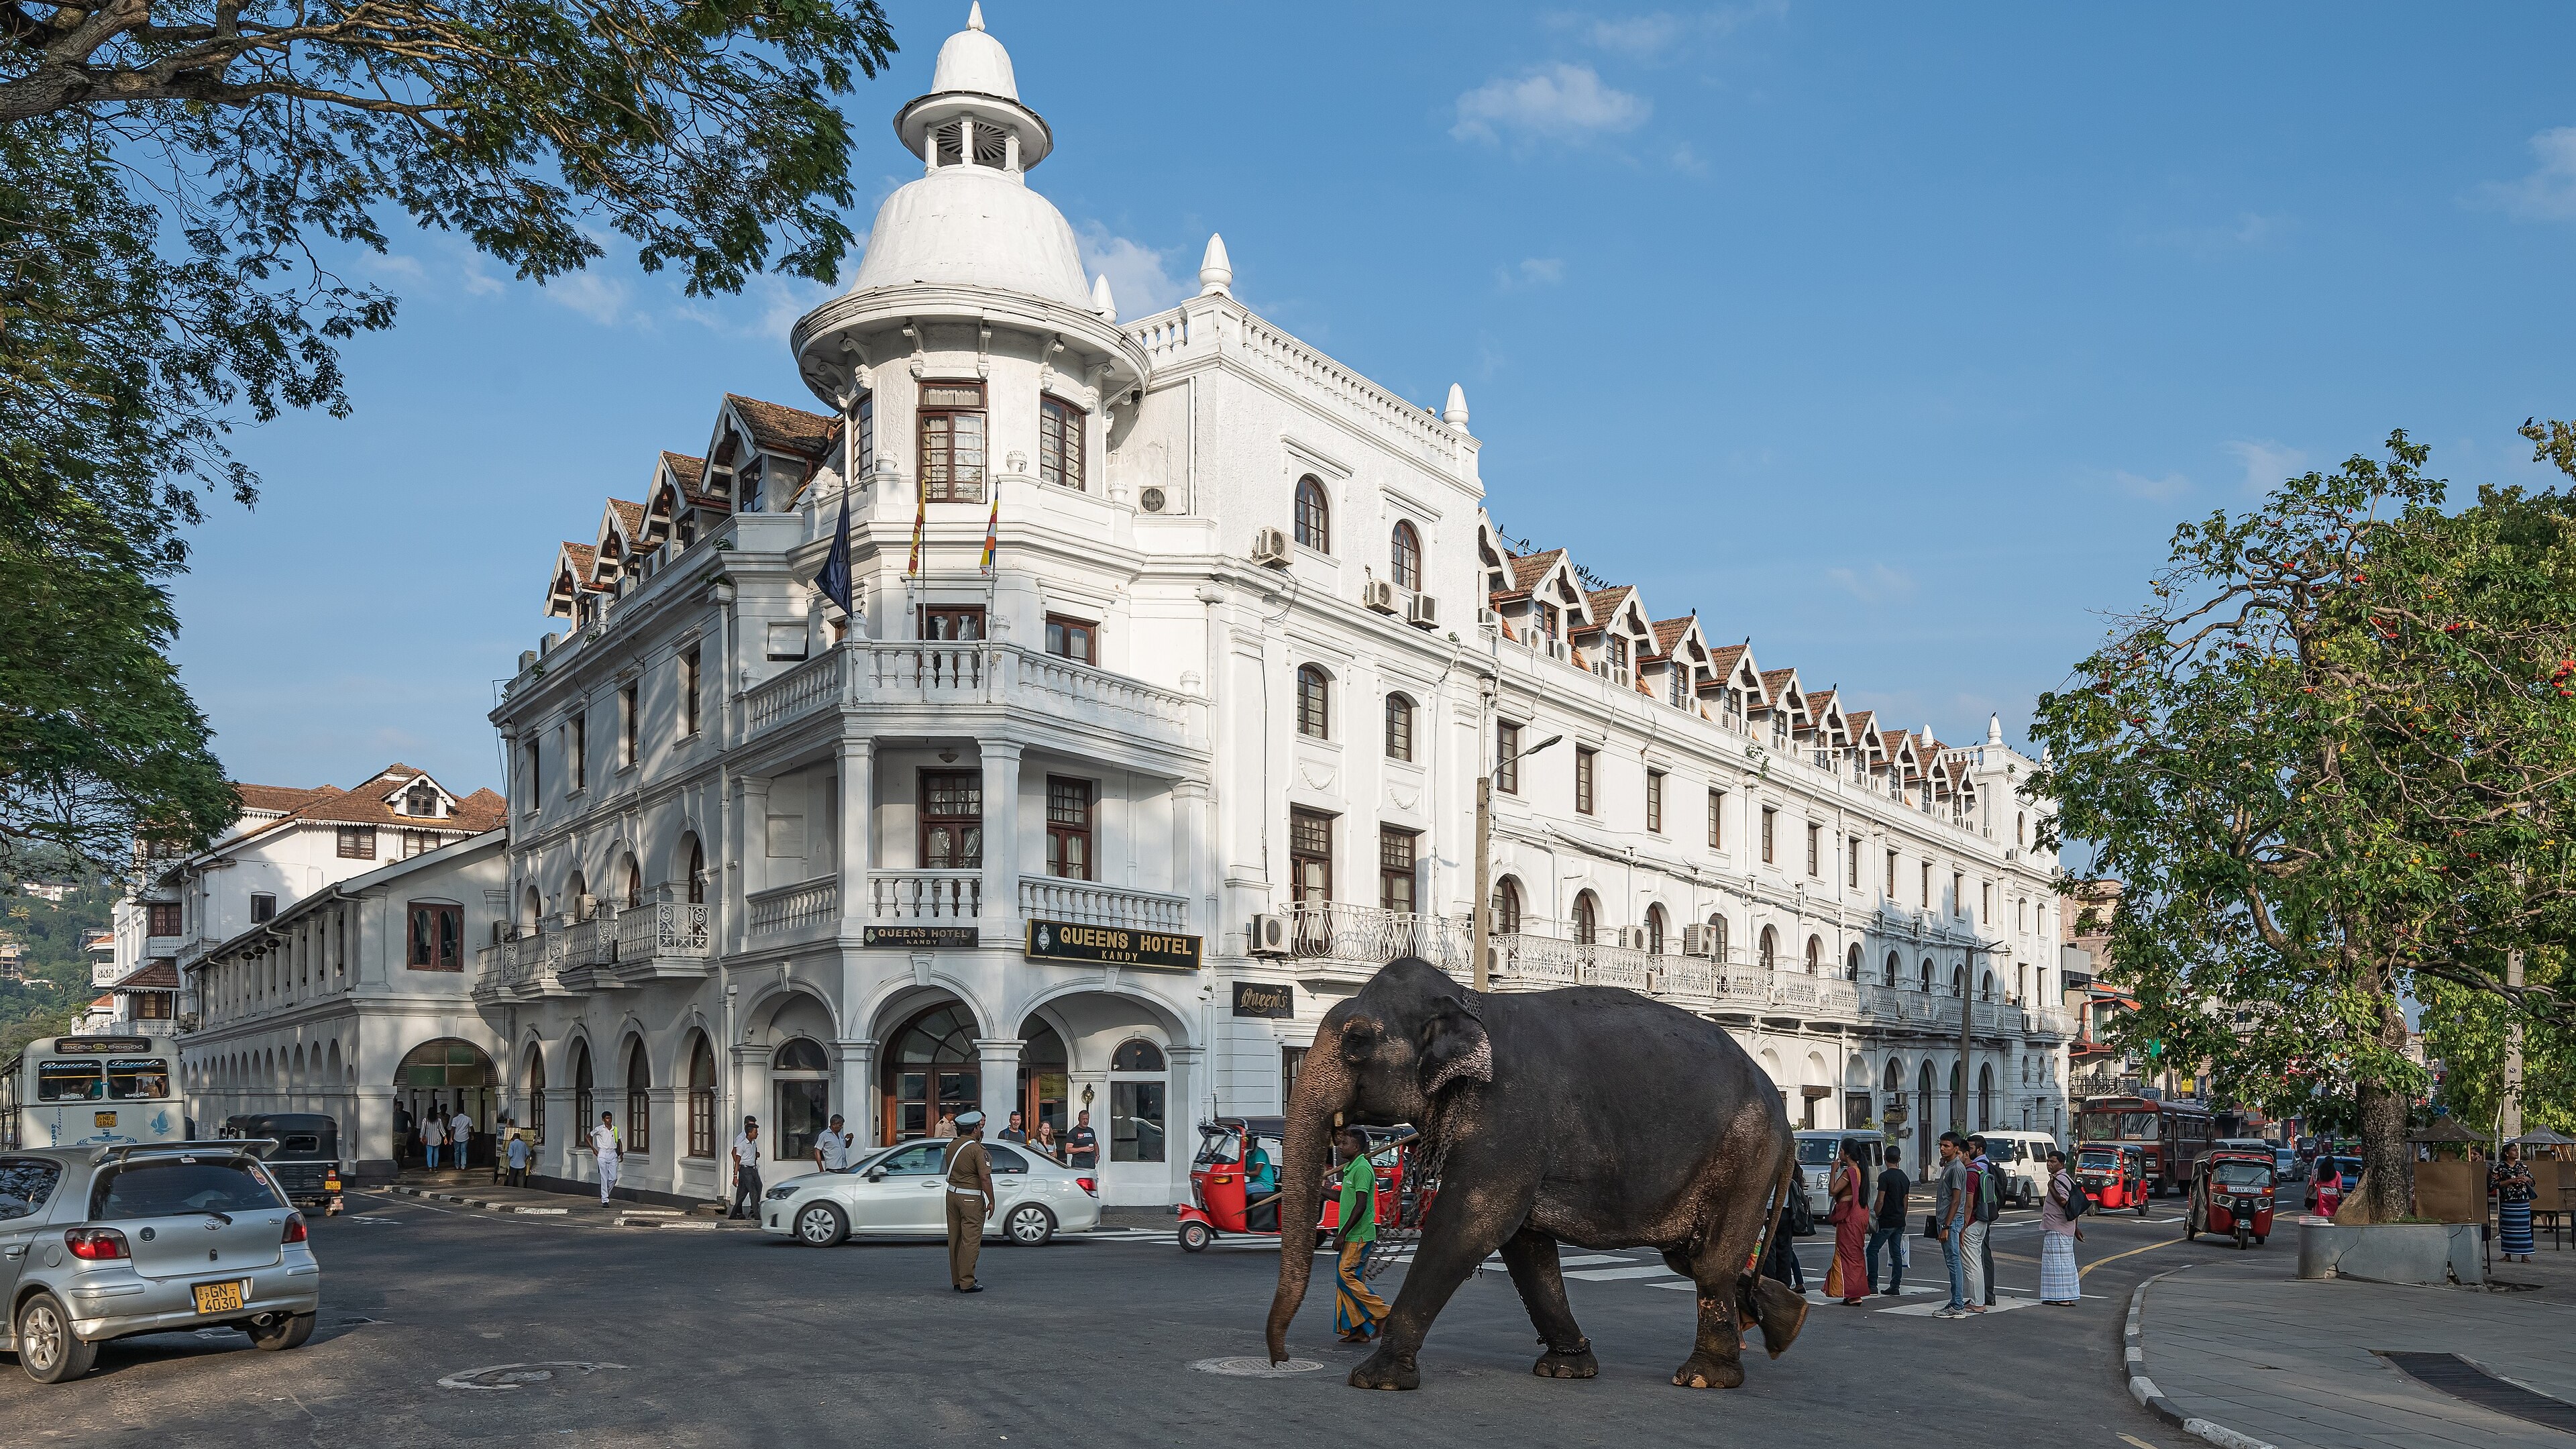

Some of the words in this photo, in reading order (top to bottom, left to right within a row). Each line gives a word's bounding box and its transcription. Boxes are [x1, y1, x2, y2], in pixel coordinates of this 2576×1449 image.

[878, 928, 926, 937] QUEEN'S
[931, 929, 967, 938] HOTEL
[1060, 926, 1128, 949] QUEEN'S
[1140, 934, 1192, 955] HOTEL
[1102, 951, 1138, 961] KANDY
[1240, 987, 1287, 1014] Queen's
[210, 1285, 228, 1298] GN
[205, 1296, 237, 1311] 4030
